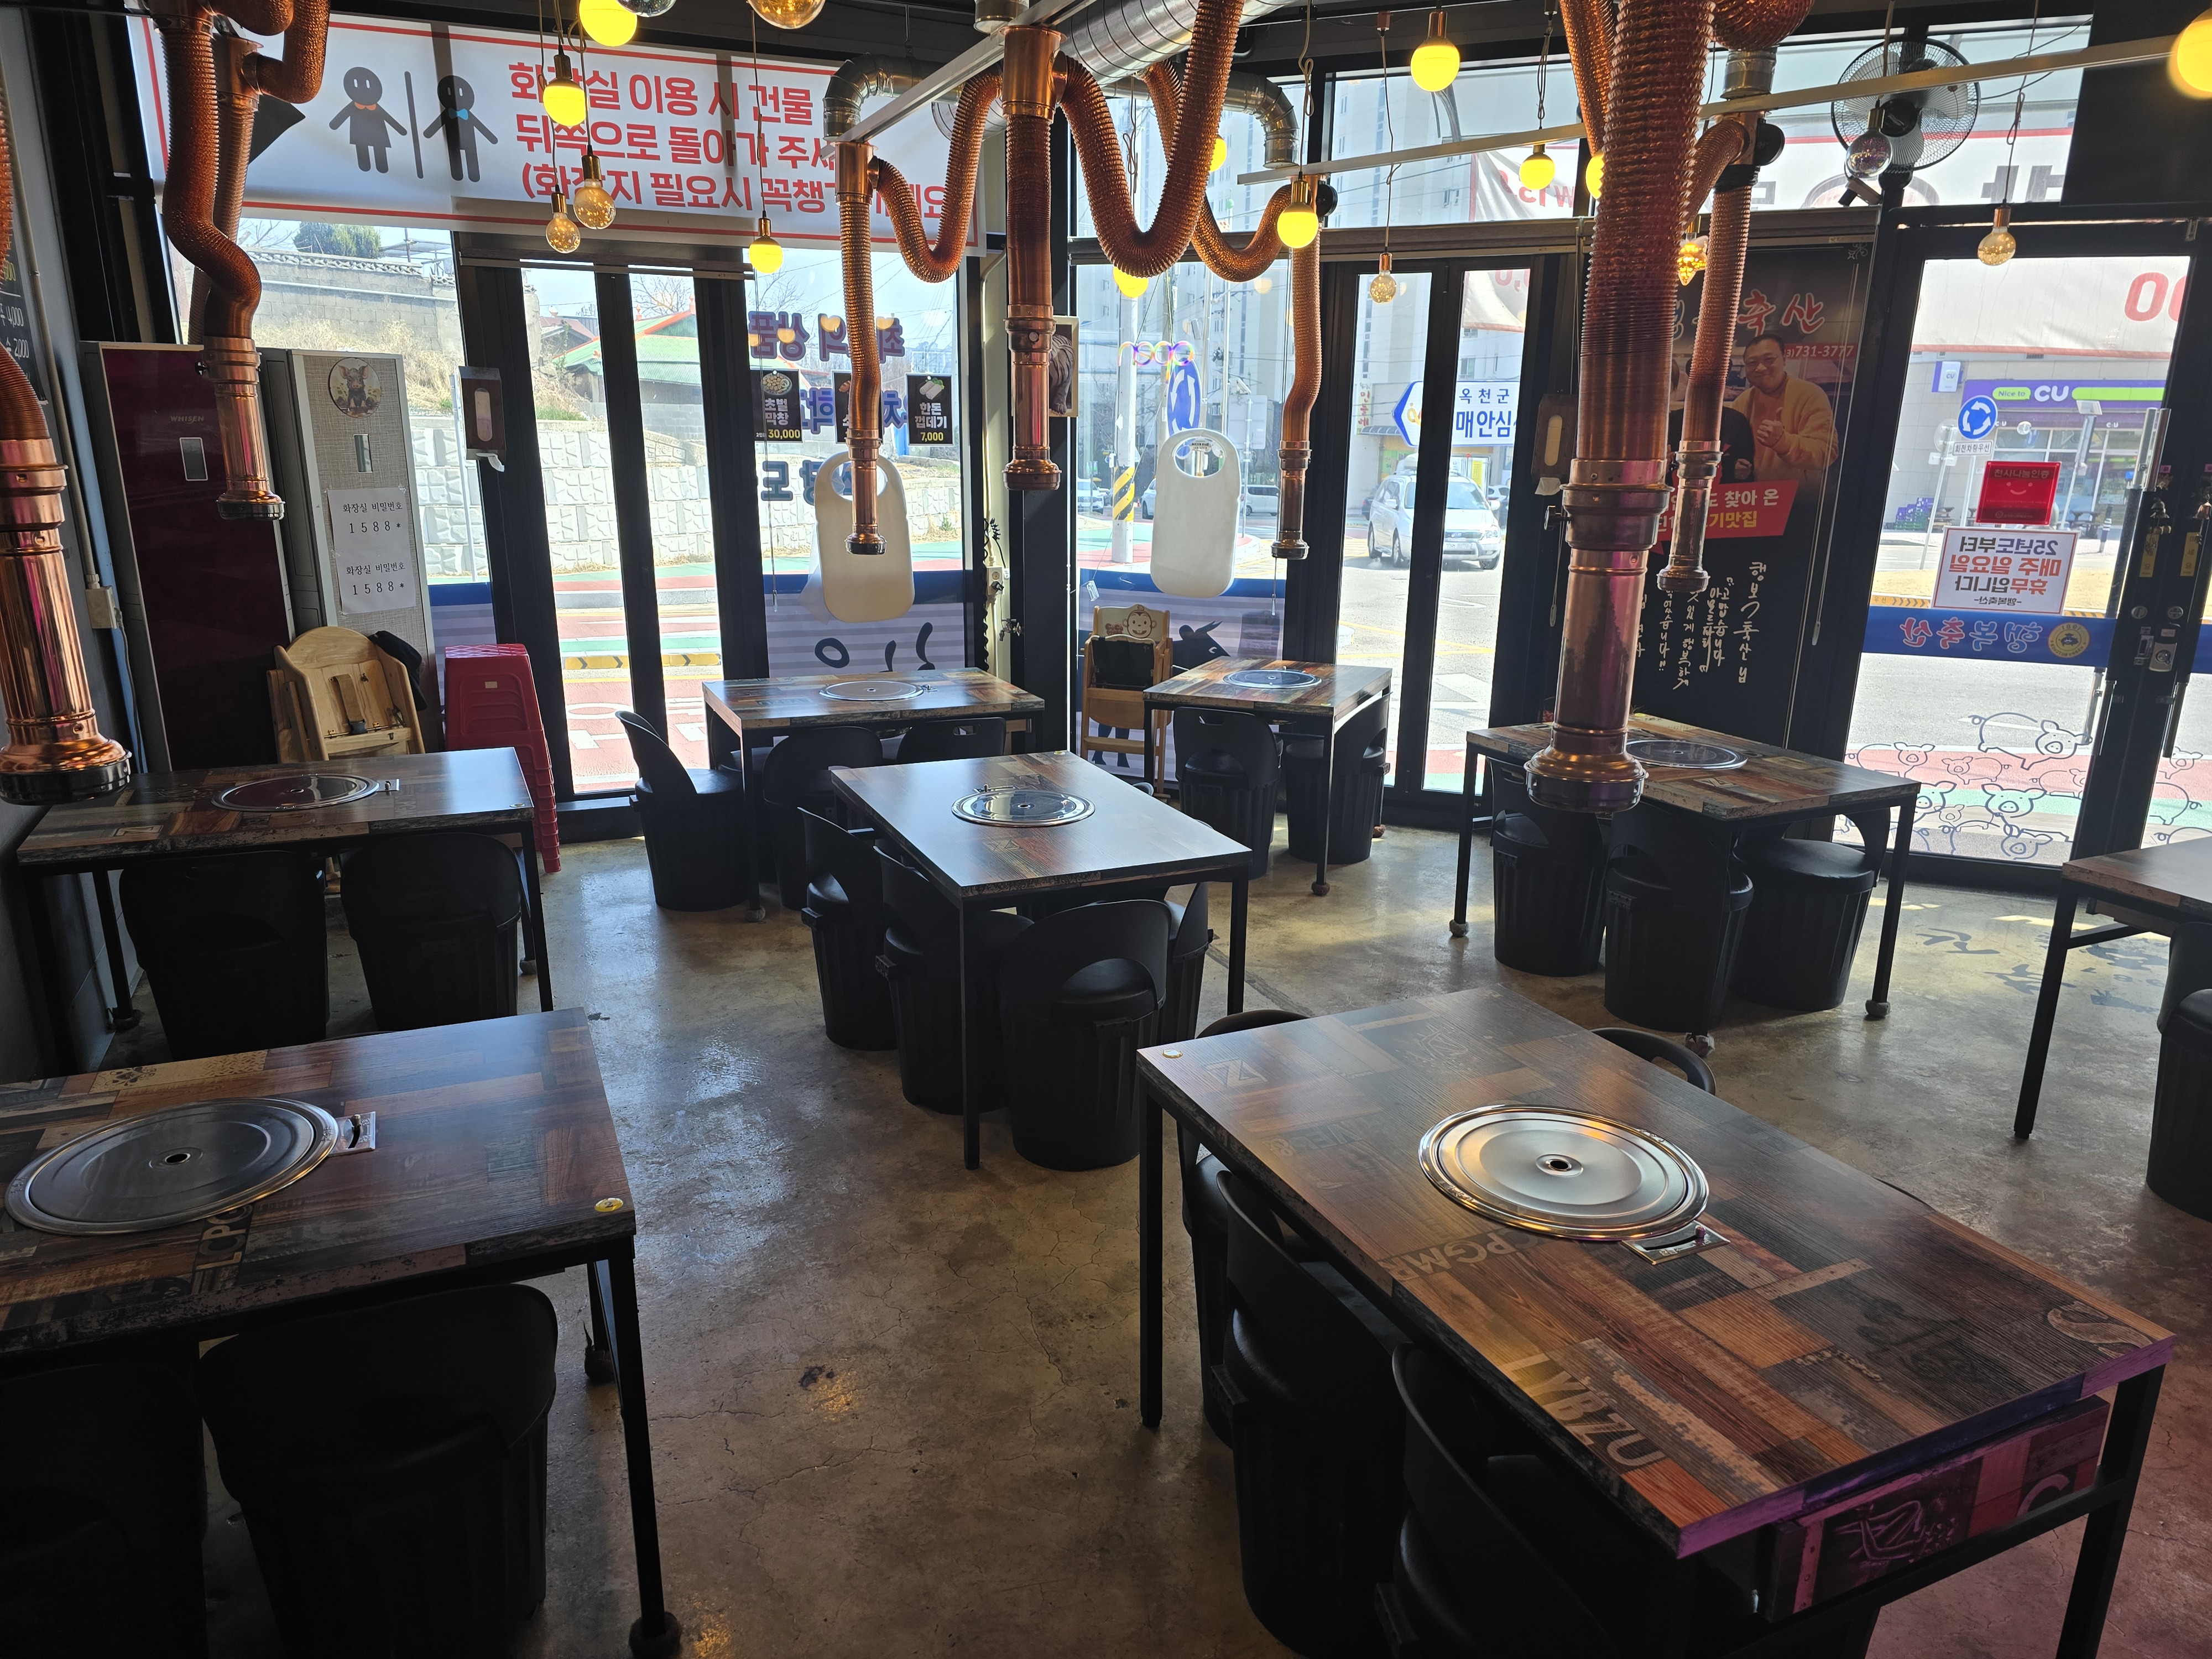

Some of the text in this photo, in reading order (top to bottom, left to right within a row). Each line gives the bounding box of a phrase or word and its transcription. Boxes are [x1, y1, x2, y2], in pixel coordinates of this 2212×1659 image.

[509, 62, 813, 126] 화실 이용 시 건물
[669, 126, 769, 168] 돌아가
[650, 173, 753, 211] 필요시
[1459, 388, 1510, 404] 옥천군
[2034, 385, 2069, 402] CU
[765, 398, 788, 411] 초벌
[919, 402, 942, 415] 한돈
[171, 415, 204, 424] WHISEN
[765, 412, 789, 426] 막창
[915, 416, 947, 429] 껍데기
[768, 429, 801, 440] 30,000
[920, 432, 944, 442] 7,000
[1954, 444, 1990, 453] 회전차량우선
[1725, 489, 1757, 508] 찾아
[1763, 488, 1780, 506] 온
[342, 501, 403, 514] 화장실 비밀번호
[1707, 510, 1757, 529] 기맛집
[346, 561, 406, 576] 화장실 비밀번호
